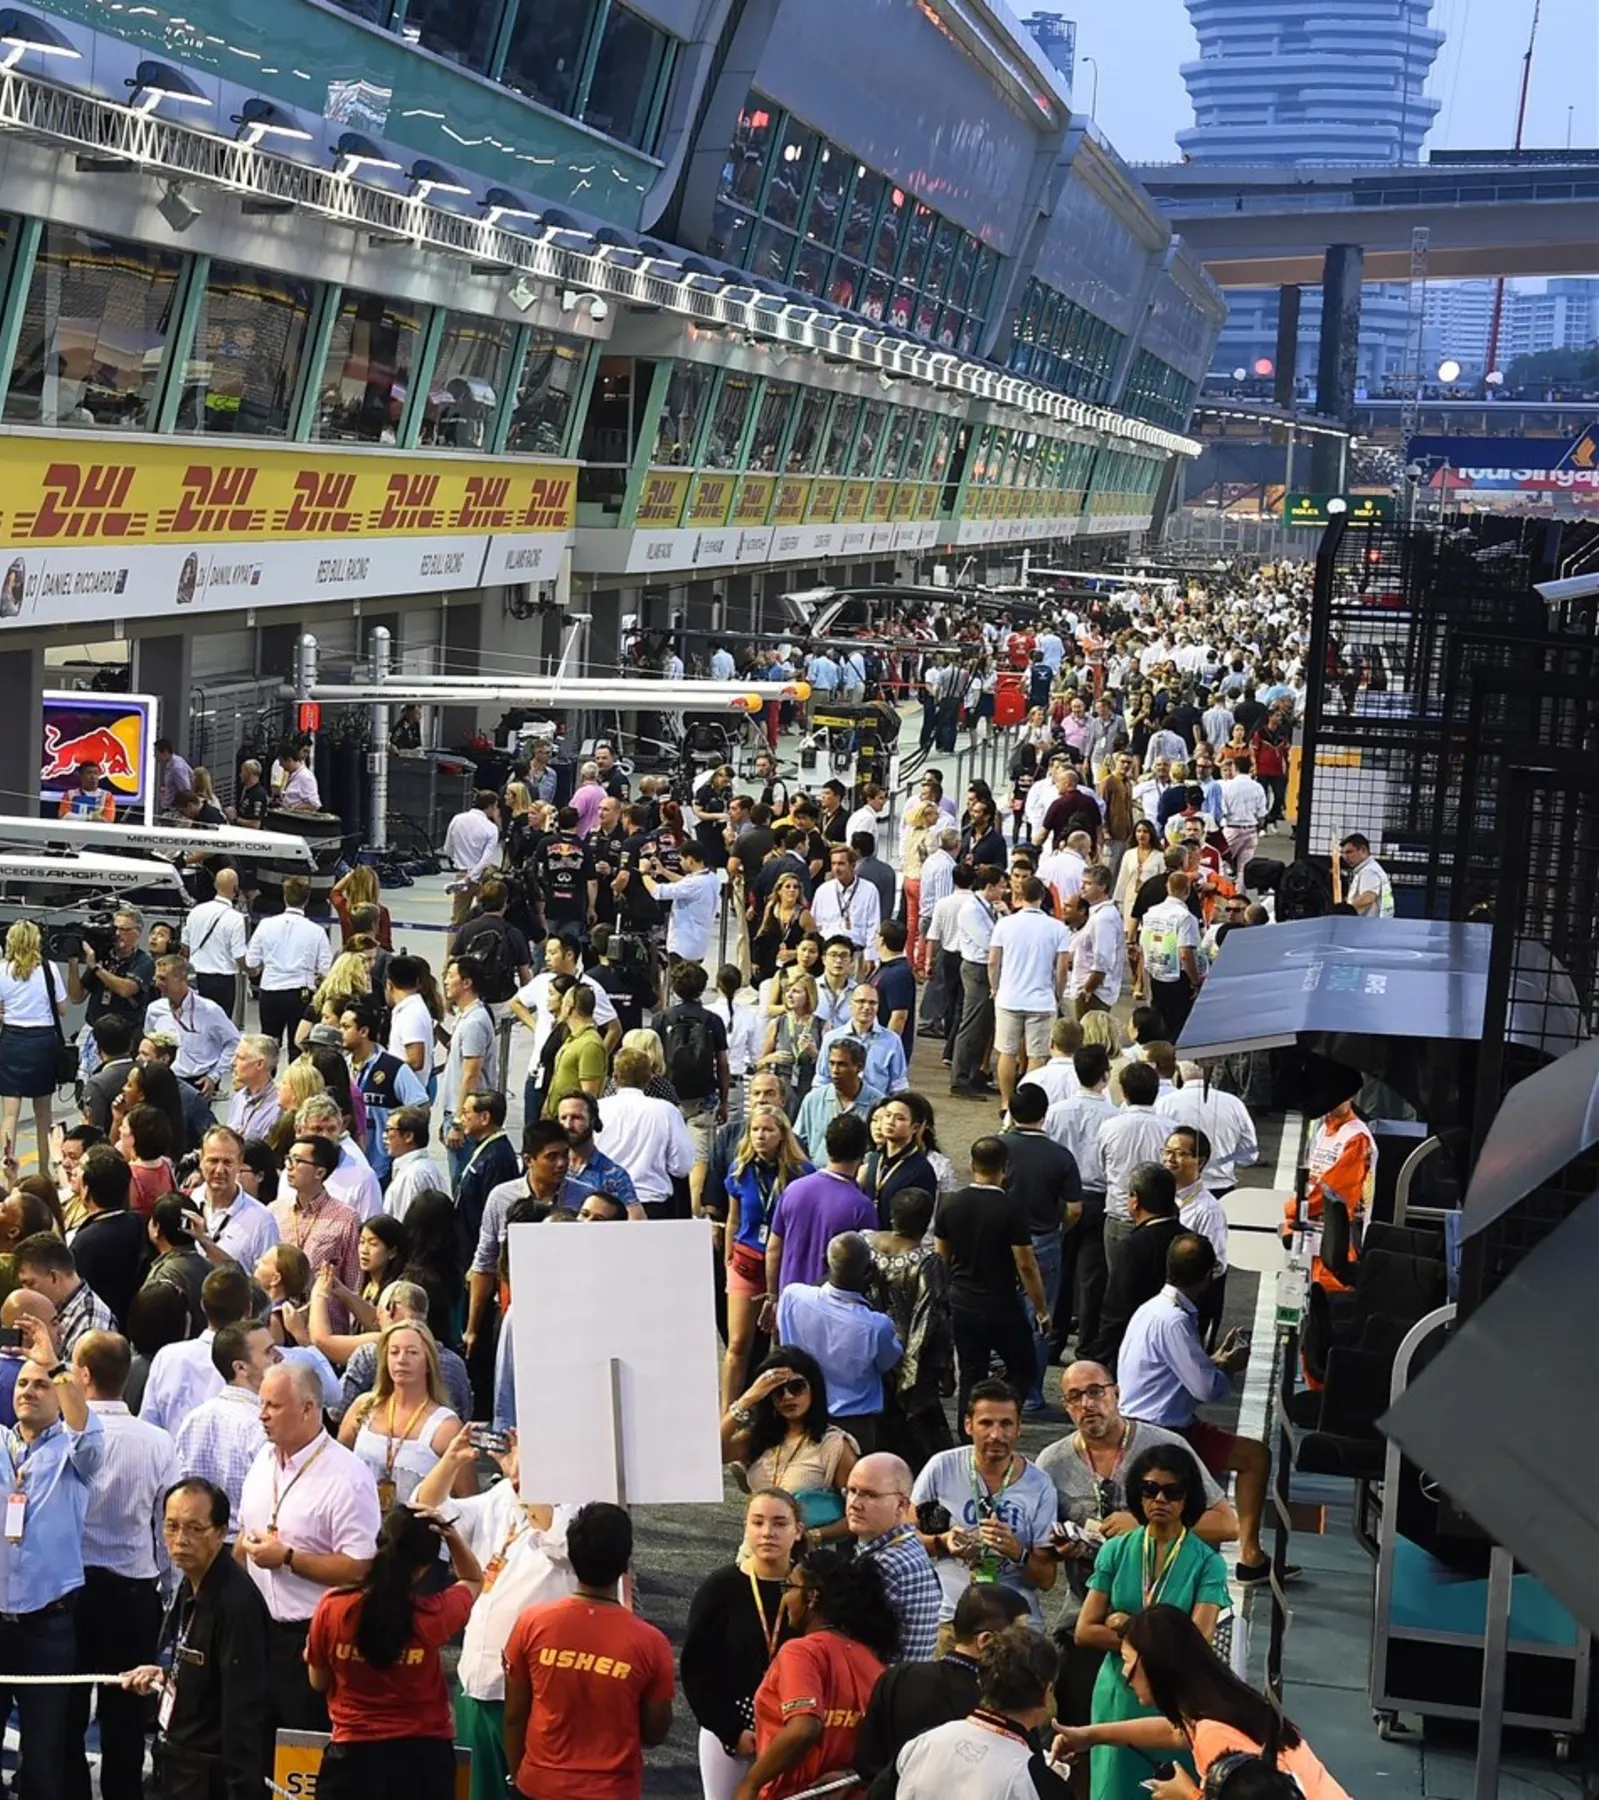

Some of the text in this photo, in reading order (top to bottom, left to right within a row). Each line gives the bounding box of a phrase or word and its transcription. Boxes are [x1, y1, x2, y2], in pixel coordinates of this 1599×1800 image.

[31, 464, 136, 537] DHL
[170, 466, 258, 531] DHL
[284, 471, 357, 532] DHL
[378, 474, 440, 528] DHL
[456, 477, 511, 527] DHL
[523, 479, 571, 527] DHL
[1354, 509, 1381, 517] ROLX
[42, 573, 71, 596] DANIEL
[538, 1648, 631, 1680] USHER
